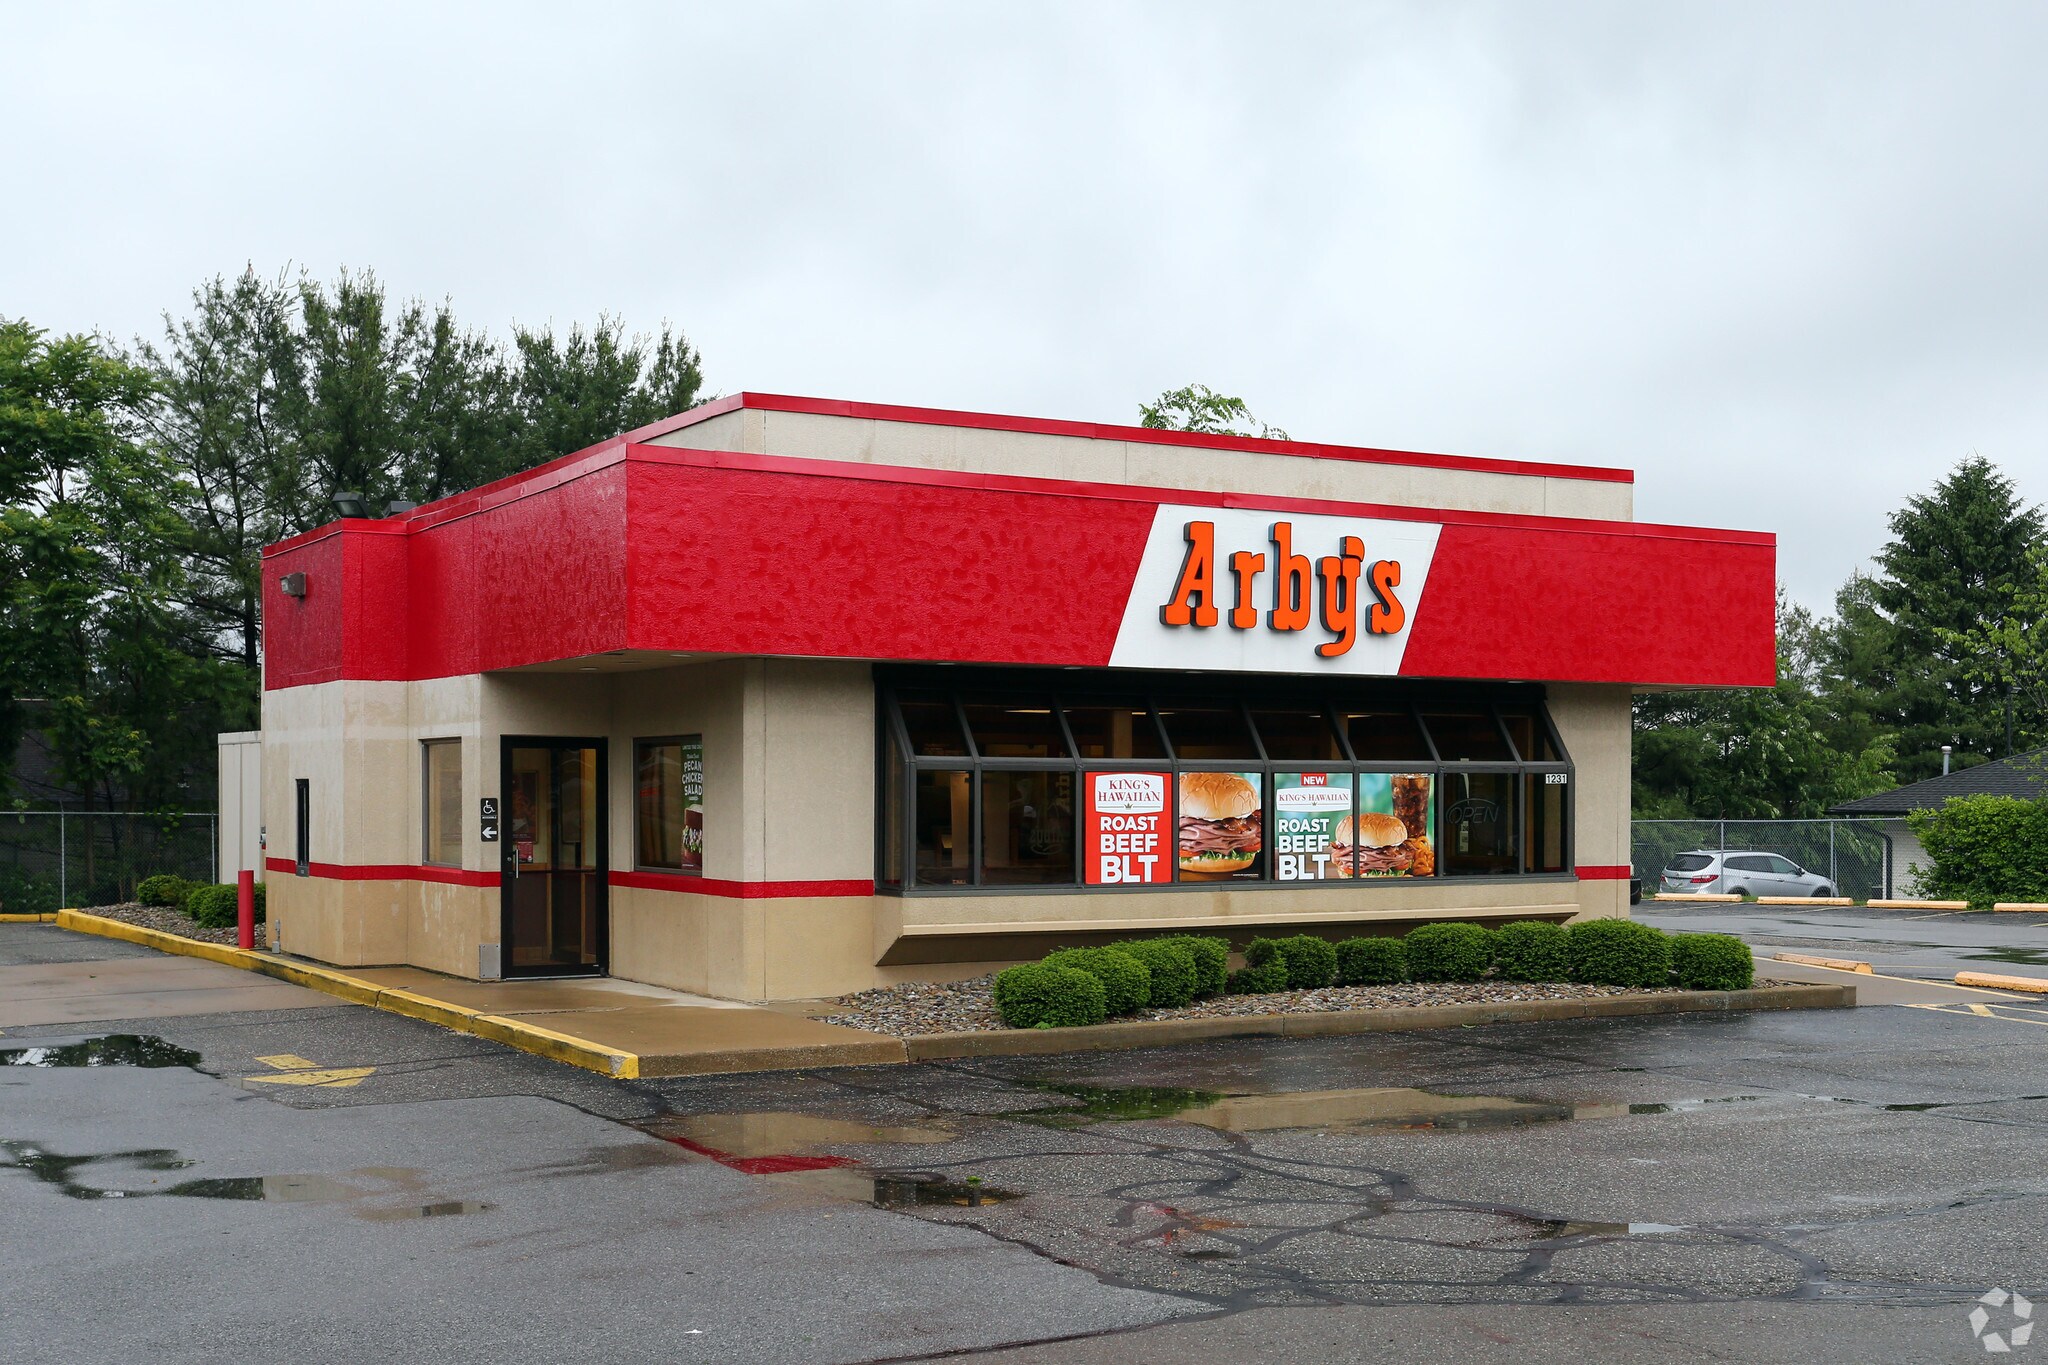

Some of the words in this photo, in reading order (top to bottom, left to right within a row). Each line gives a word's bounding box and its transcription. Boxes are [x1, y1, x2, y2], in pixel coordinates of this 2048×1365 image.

[1159, 521, 1405, 657] Arby's
[1109, 778, 1150, 790] KING'S
[1303, 776, 1325, 785] NEW
[1546, 773, 1567, 784] 1231
[684, 784, 703, 796] SALAD
[1098, 790, 1160, 802] HAWAIIAN
[1279, 792, 1306, 802] KING'S
[1308, 792, 1349, 802] HAWAIIAN
[1448, 806, 1500, 824] OPEN
[1100, 816, 1158, 831] ROAST
[1278, 818, 1329, 833] ROAST
[1100, 834, 1158, 853] BEEF
[1278, 834, 1330, 853] BEEF
[1100, 855, 1158, 883] BLT
[1278, 854, 1330, 880] BLT
